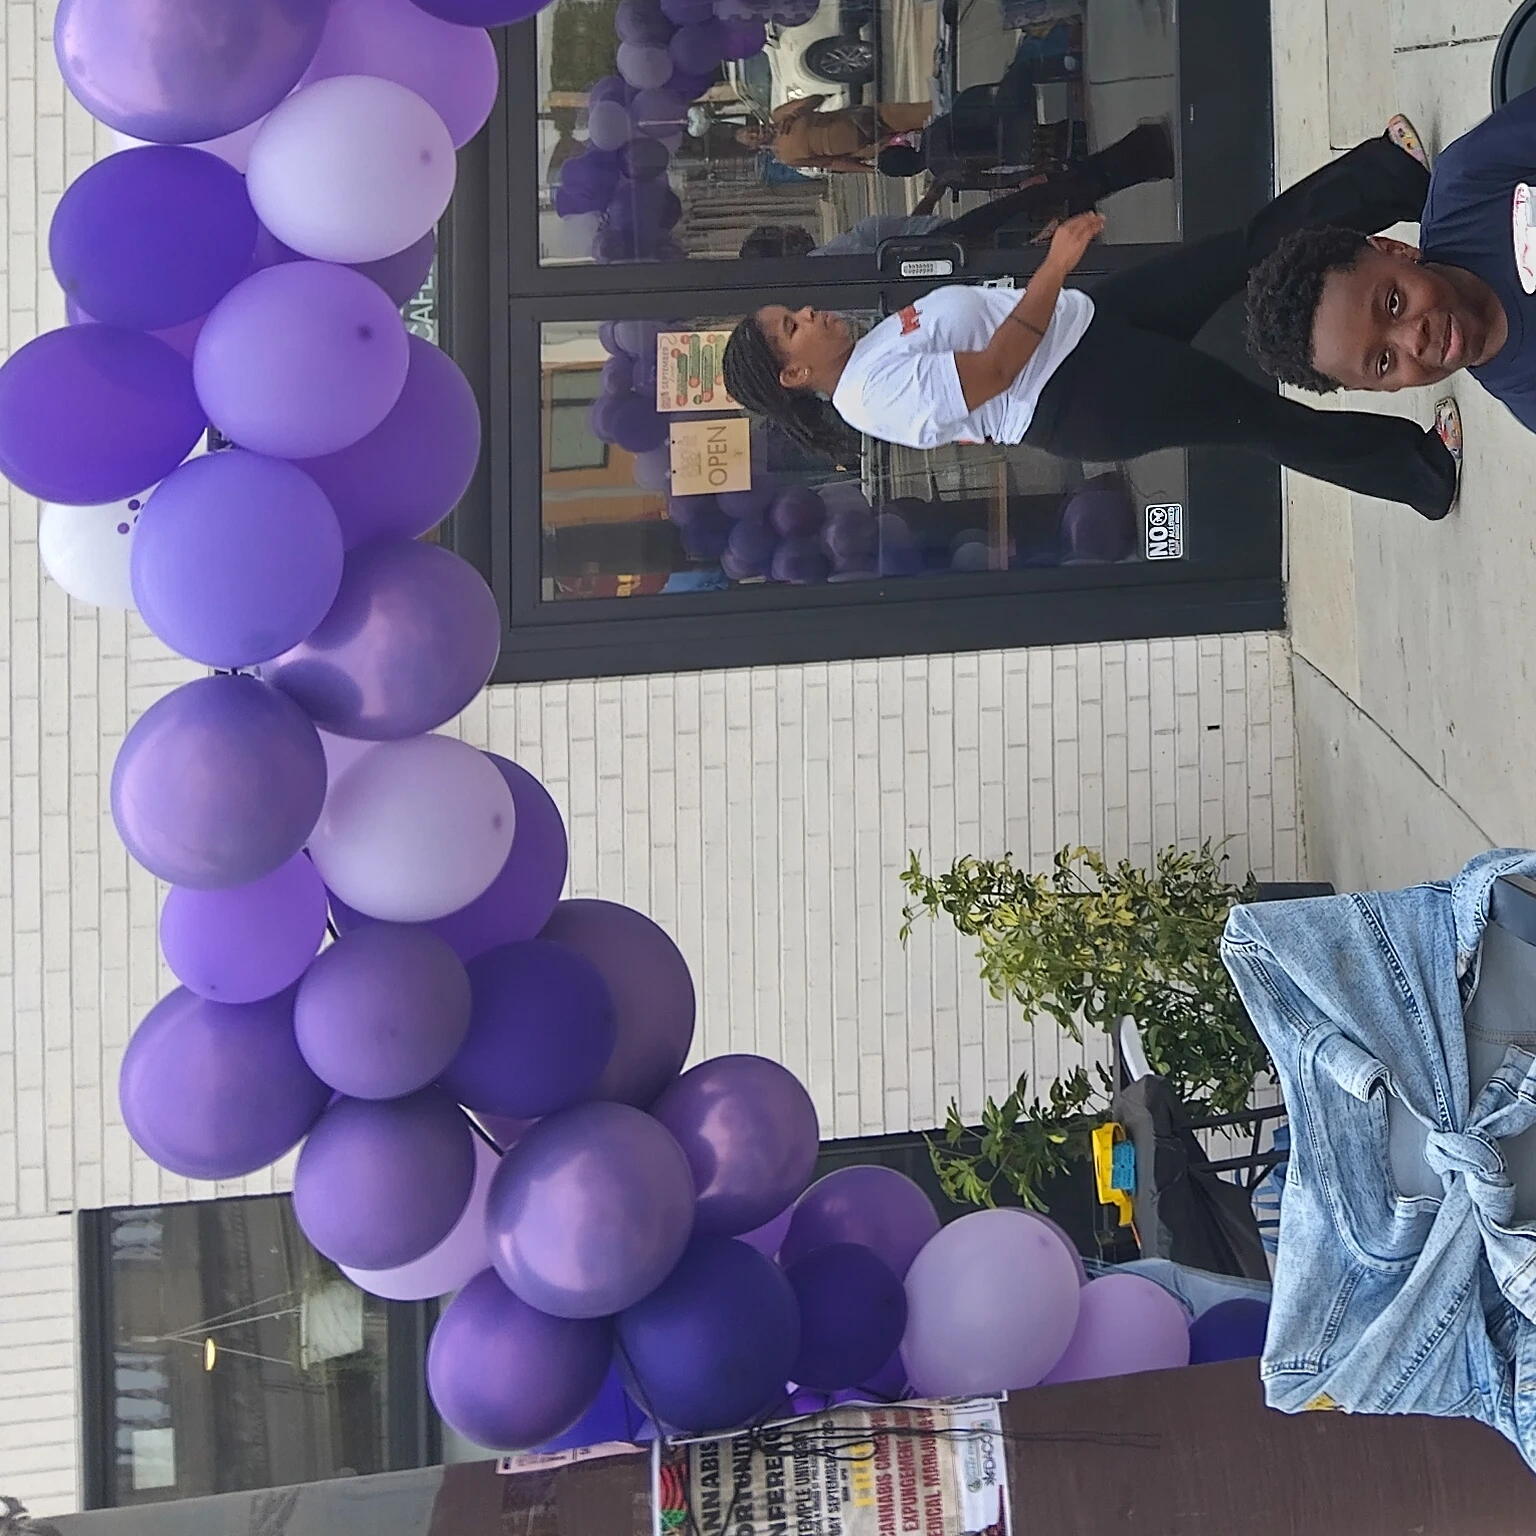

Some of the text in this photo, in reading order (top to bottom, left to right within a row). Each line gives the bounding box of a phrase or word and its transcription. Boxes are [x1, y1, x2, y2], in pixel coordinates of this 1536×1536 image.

[706, 426, 728, 486] OPEN
[1149, 526, 1168, 556] NO
[898, 1439, 920, 1532] EXPUNGEMENT
